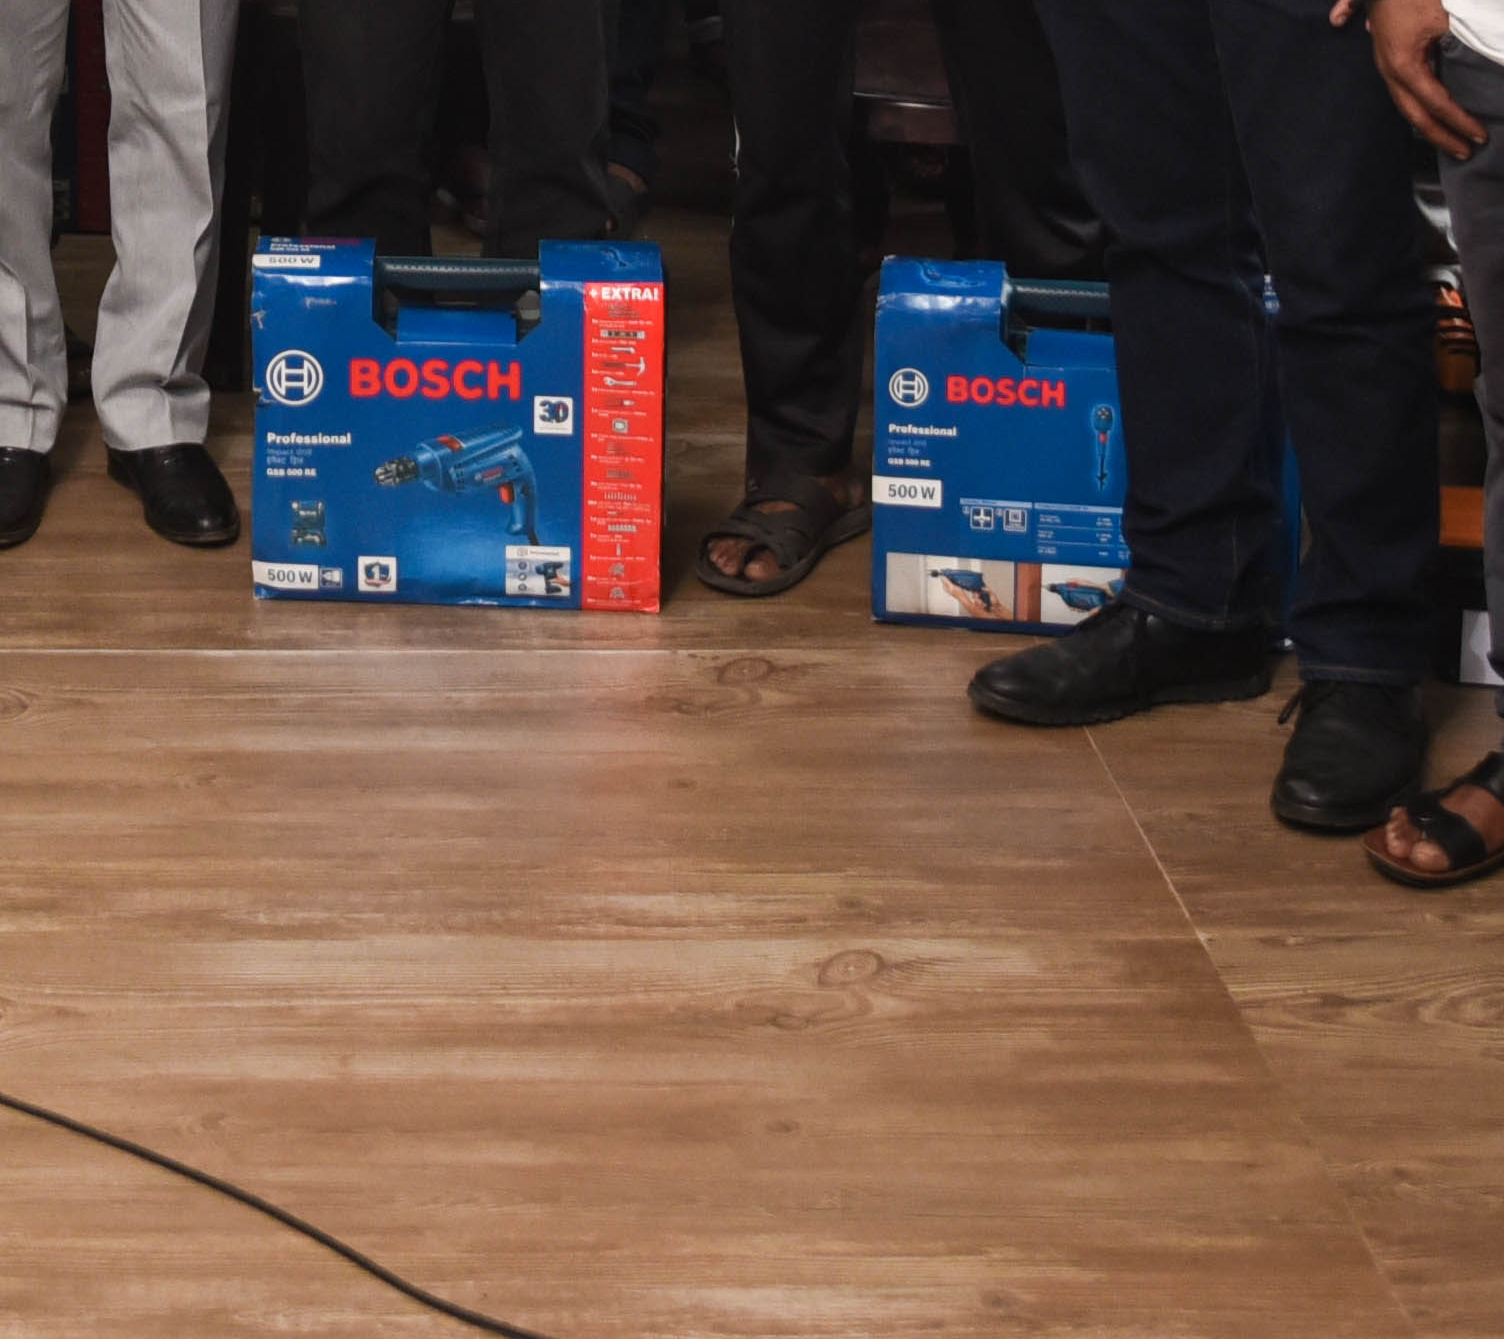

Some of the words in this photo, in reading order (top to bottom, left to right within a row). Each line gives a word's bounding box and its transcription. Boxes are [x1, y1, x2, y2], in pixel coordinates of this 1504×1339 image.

[601, 286, 659, 300] EXTRA!
[348, 357, 522, 400] BOSCH
[945, 374, 1066, 408] BOSCH
[888, 423, 958, 437] Professional
[266, 431, 352, 445] Professional
[888, 483, 918, 499] 500
[921, 485, 936, 500] W
[267, 568, 296, 583] 500
[299, 570, 313, 583] W
